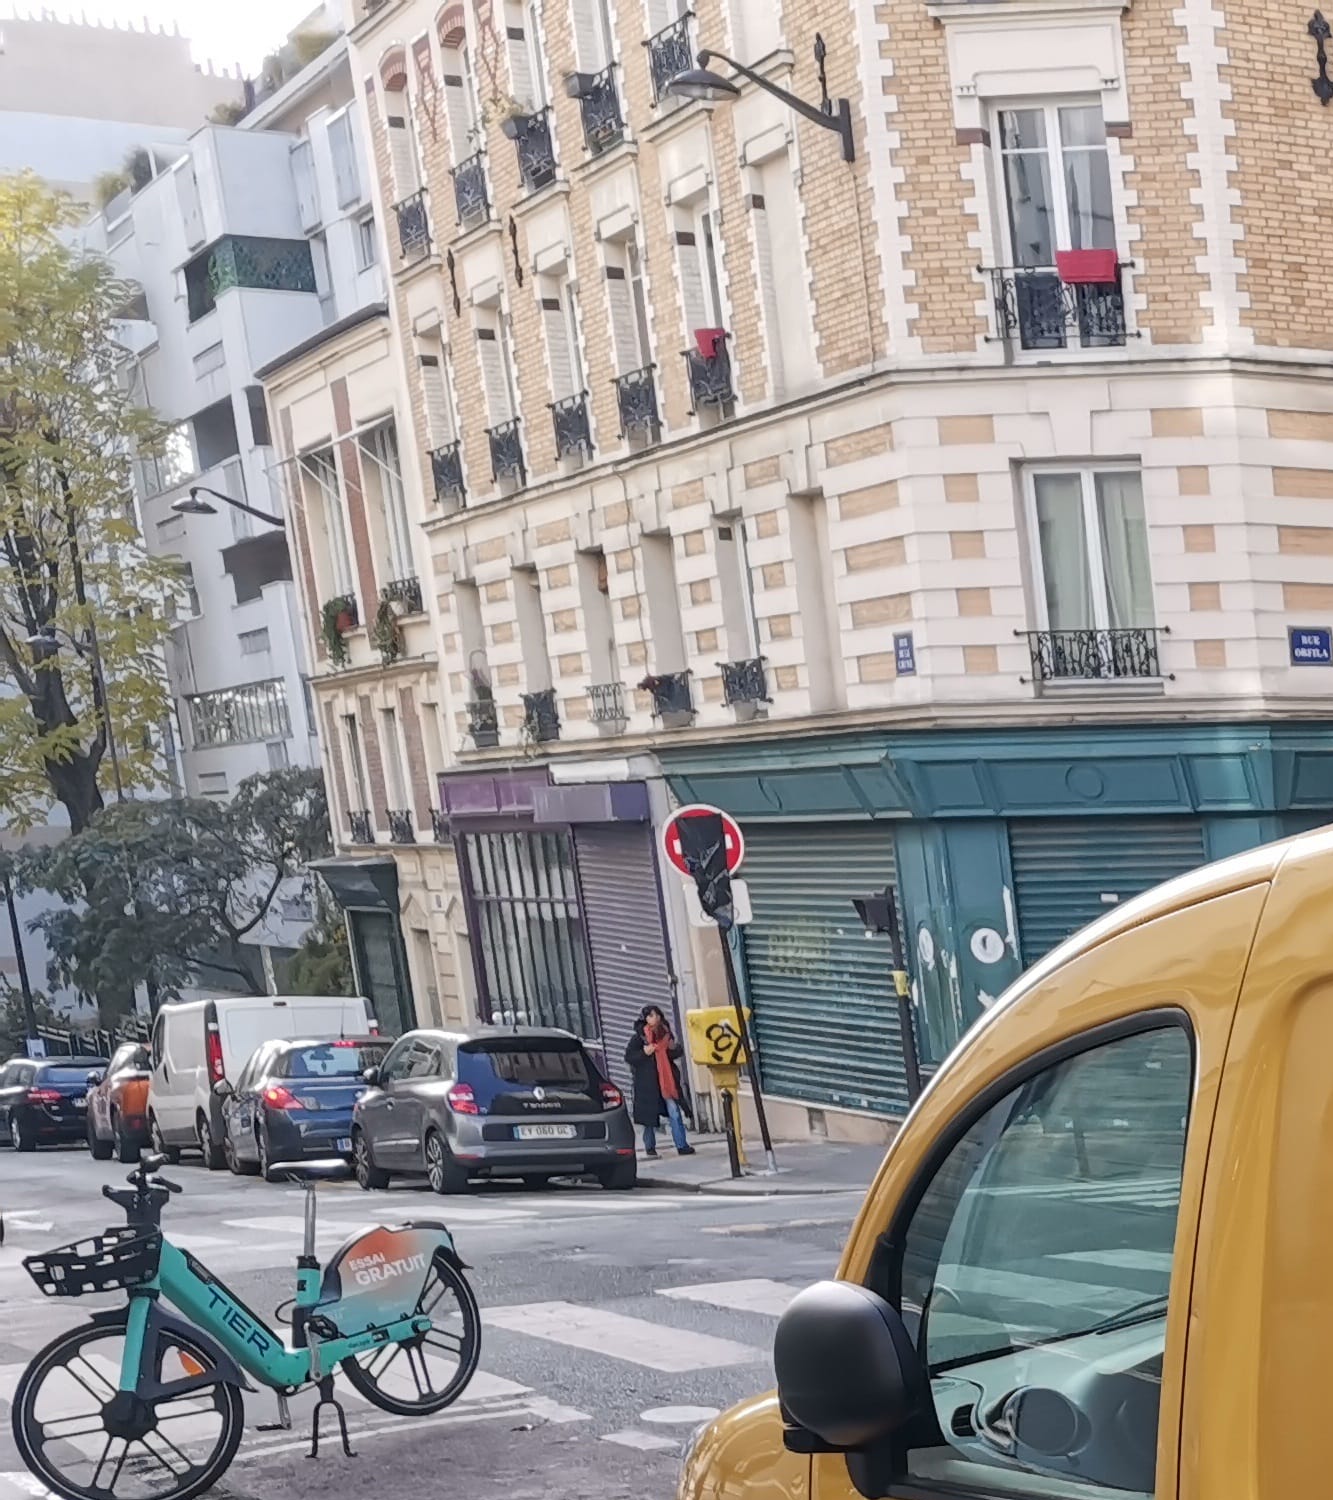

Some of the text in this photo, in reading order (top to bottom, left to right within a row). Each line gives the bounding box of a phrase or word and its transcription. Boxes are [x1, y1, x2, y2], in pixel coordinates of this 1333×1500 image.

[1300, 635, 1321, 646] RUE
[349, 1252, 386, 1271] ESSAI
[355, 1253, 427, 1286] GRATUIT
[208, 1286, 270, 1357] TIER
